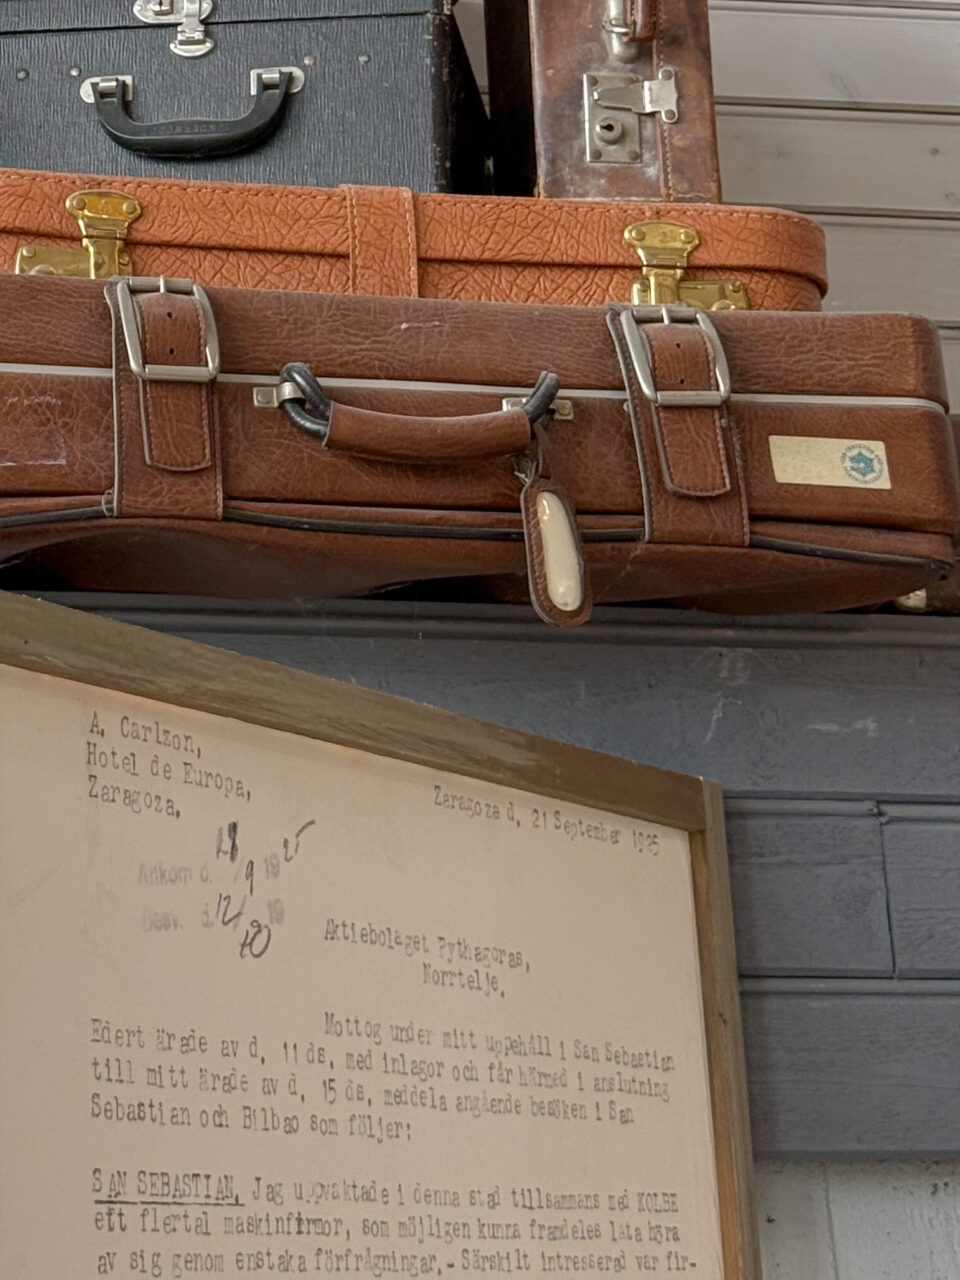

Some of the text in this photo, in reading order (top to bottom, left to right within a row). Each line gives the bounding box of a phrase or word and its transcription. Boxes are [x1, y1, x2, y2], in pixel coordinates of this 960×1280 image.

[89, 710, 201, 758] A. Carlzon,
[86, 741, 251, 802] Hotel de Europa,
[88, 774, 181, 819] Zaragoza.
[434, 785, 500, 818] Zaragoza
[532, 808, 547, 830] 21
[554, 810, 621, 842] September
[324, 918, 530, 973] Aktiebolaget Pythagoras,
[423, 963, 505, 999] Norrtelje.
[91, 1018, 145, 1049] Edert
[156, 1028, 208, 1055] ärade
[220, 1039, 239, 1059] av
[283, 1041, 298, 1064] 11
[345, 1050, 373, 1071] med
[383, 1051, 444, 1082] inlagor
[452, 1059, 479, 1082] och
[488, 1060, 513, 1084] får
[519, 1065, 568, 1089] härmed
[578, 1071, 585, 1091] i
[594, 1071, 670, 1103] anslutning
[324, 1011, 675, 1072] Mottog under mitt uppehåll i San Sebastian
[91, 1092, 192, 1127] Sebastian
[200, 1104, 230, 1129] och
[242, 1104, 300, 1135] Bilbao
[310, 1113, 338, 1136] som
[92, 1057, 135, 1084] till
[146, 1065, 189, 1089] mitt
[199, 1067, 249, 1094] ärade
[262, 1076, 280, 1097] av
[323, 1078, 337, 1105] 15
[383, 1084, 448, 1112] meddela
[456, 1089, 522, 1118] angående
[531, 1096, 588, 1120] besöken
[596, 1101, 603, 1121] i
[609, 1100, 635, 1125] San
[92, 1168, 127, 1198] SAN
[253, 1176, 283, 1206] Jag
[294, 1179, 389, 1205] uppvaktade
[397, 1183, 405, 1206] i
[413, 1182, 460, 1207] denna
[469, 1186, 500, 1209] stad
[511, 1187, 600, 1211] tillsammans
[608, 1189, 630, 1212] med
[637, 1192, 679, 1213] KOLBE
[94, 1206, 127, 1232] ett
[140, 1207, 211, 1236] flertal
[362, 1218, 390, 1238] som
[398, 1214, 471, 1244] möjligen
[477, 1218, 522, 1240] kunna
[529, 1218, 602, 1242] framdeles
[97, 1251, 118, 1275] av
[130, 1249, 162, 1278] sig
[172, 1251, 225, 1278] genom
[236, 1248, 307, 1273] enstaka
[462, 1248, 530, 1273] Särskilt
[541, 1250, 626, 1274] intresserad
[635, 1253, 659, 1272] var
[667, 1251, 696, 1272] fir-
